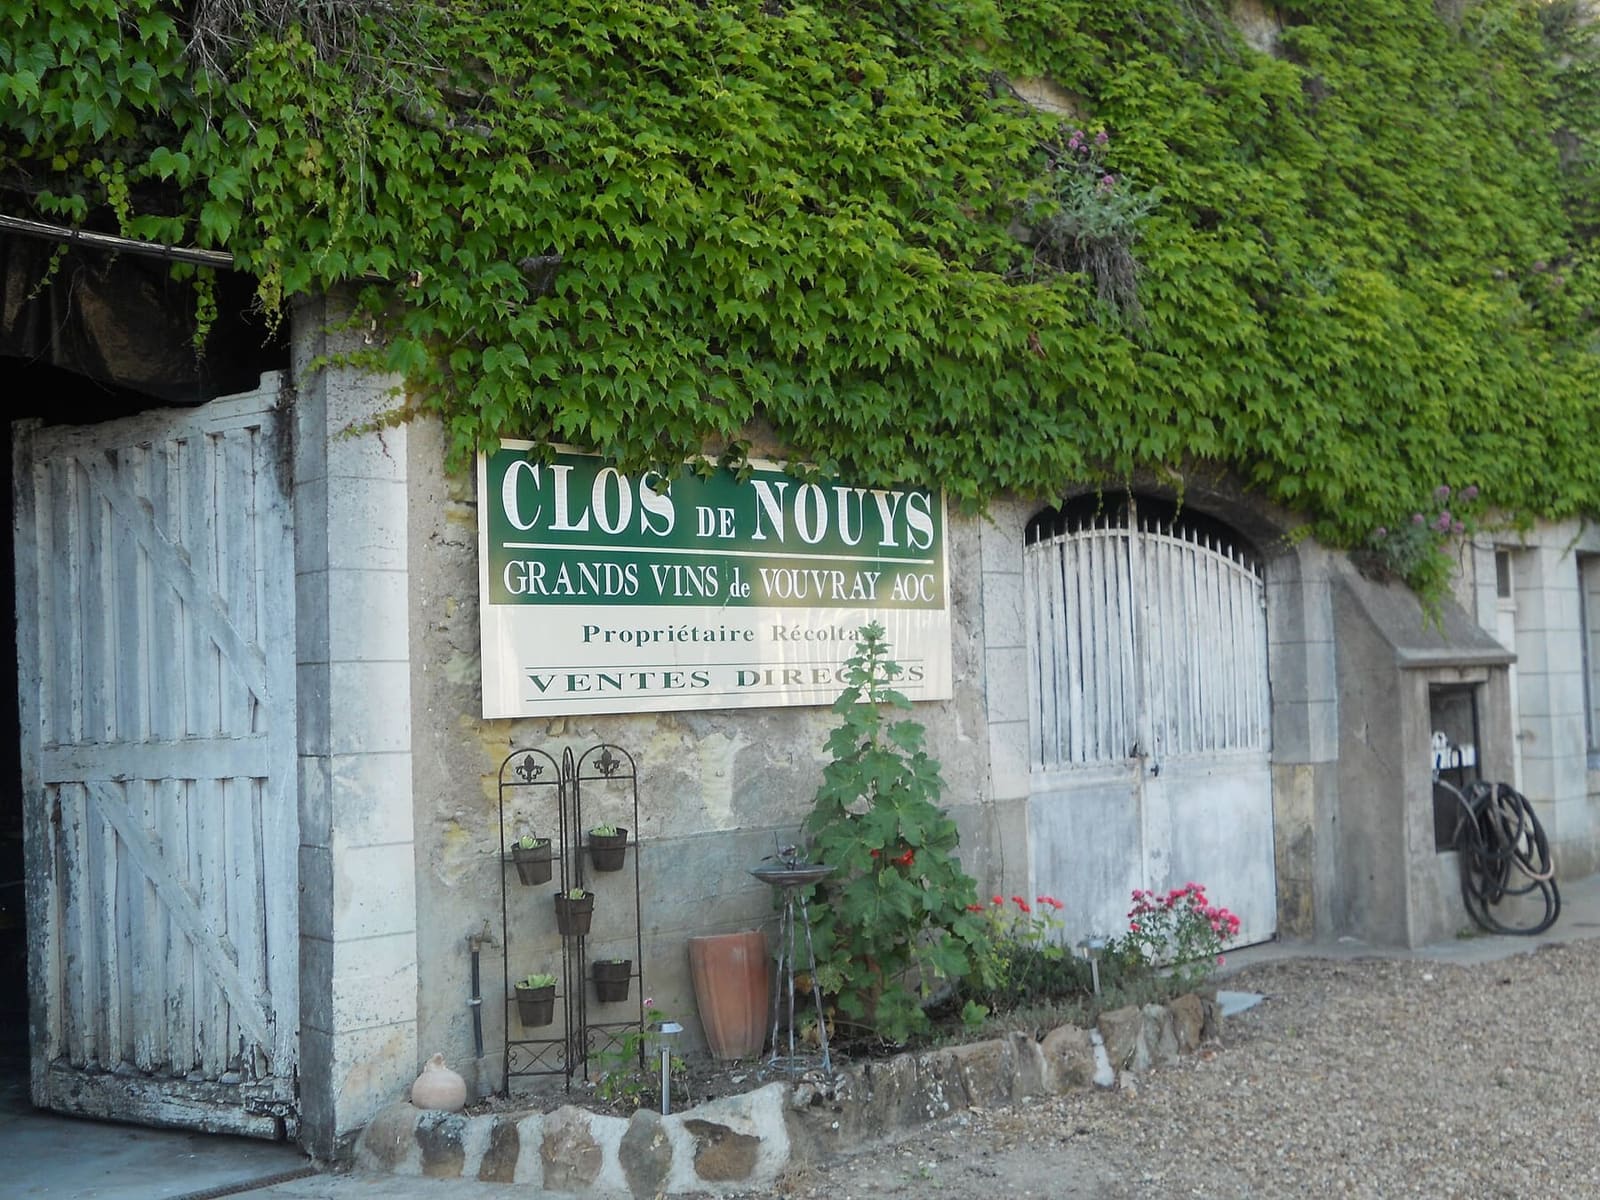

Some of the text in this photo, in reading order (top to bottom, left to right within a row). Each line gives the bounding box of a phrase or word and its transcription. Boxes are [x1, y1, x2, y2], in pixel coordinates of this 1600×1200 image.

[501, 460, 935, 550] CLOS DE NOUYS
[503, 560, 935, 602] GRANDS VINS de VOUVRAY AOC
[582, 624, 884, 647] Propriétaire Récolta
[528, 670, 711, 694] VENTES
